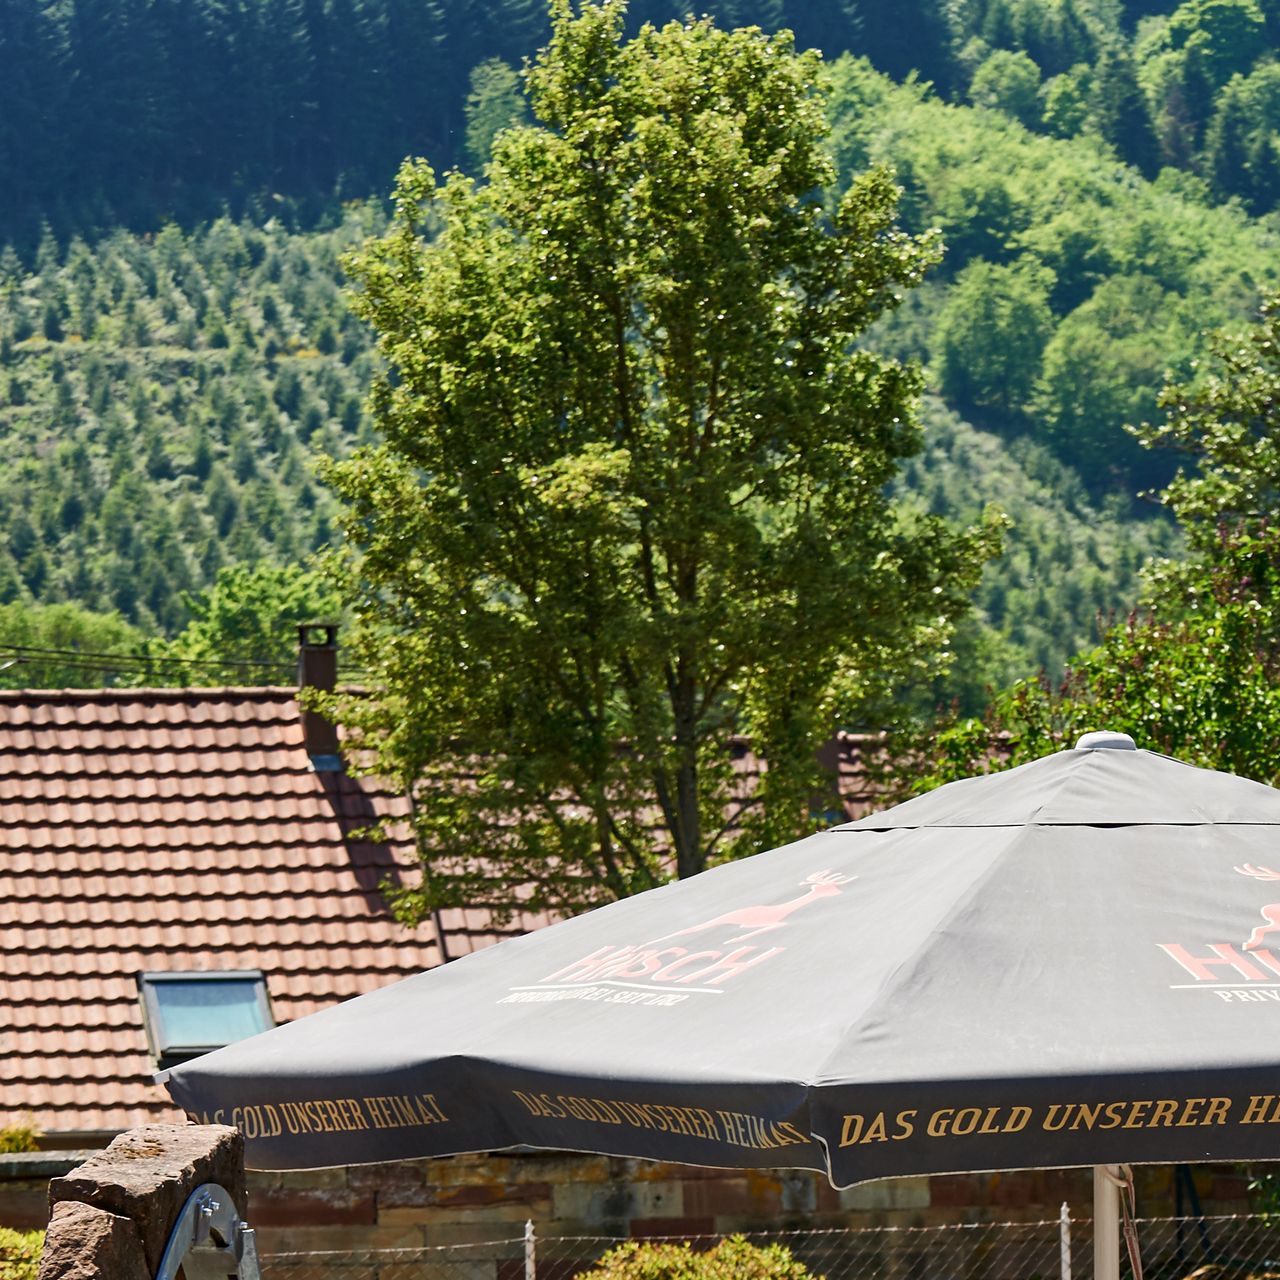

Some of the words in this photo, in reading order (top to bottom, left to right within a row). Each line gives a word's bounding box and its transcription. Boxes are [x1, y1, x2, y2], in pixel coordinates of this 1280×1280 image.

[232, 1104, 282, 1139] GOLD
[279, 1097, 368, 1136] UNSERER
[366, 1093, 449, 1127] HEIMAT
[512, 1090, 566, 1119] DAS
[558, 1095, 622, 1125] GOLD
[614, 1101, 721, 1141] UNSERER
[716, 1110, 811, 1150] HEIMAT
[838, 1109, 918, 1149] DAS
[927, 1105, 1033, 1138] GOLD
[1042, 1095, 1235, 1132] UNSERER
